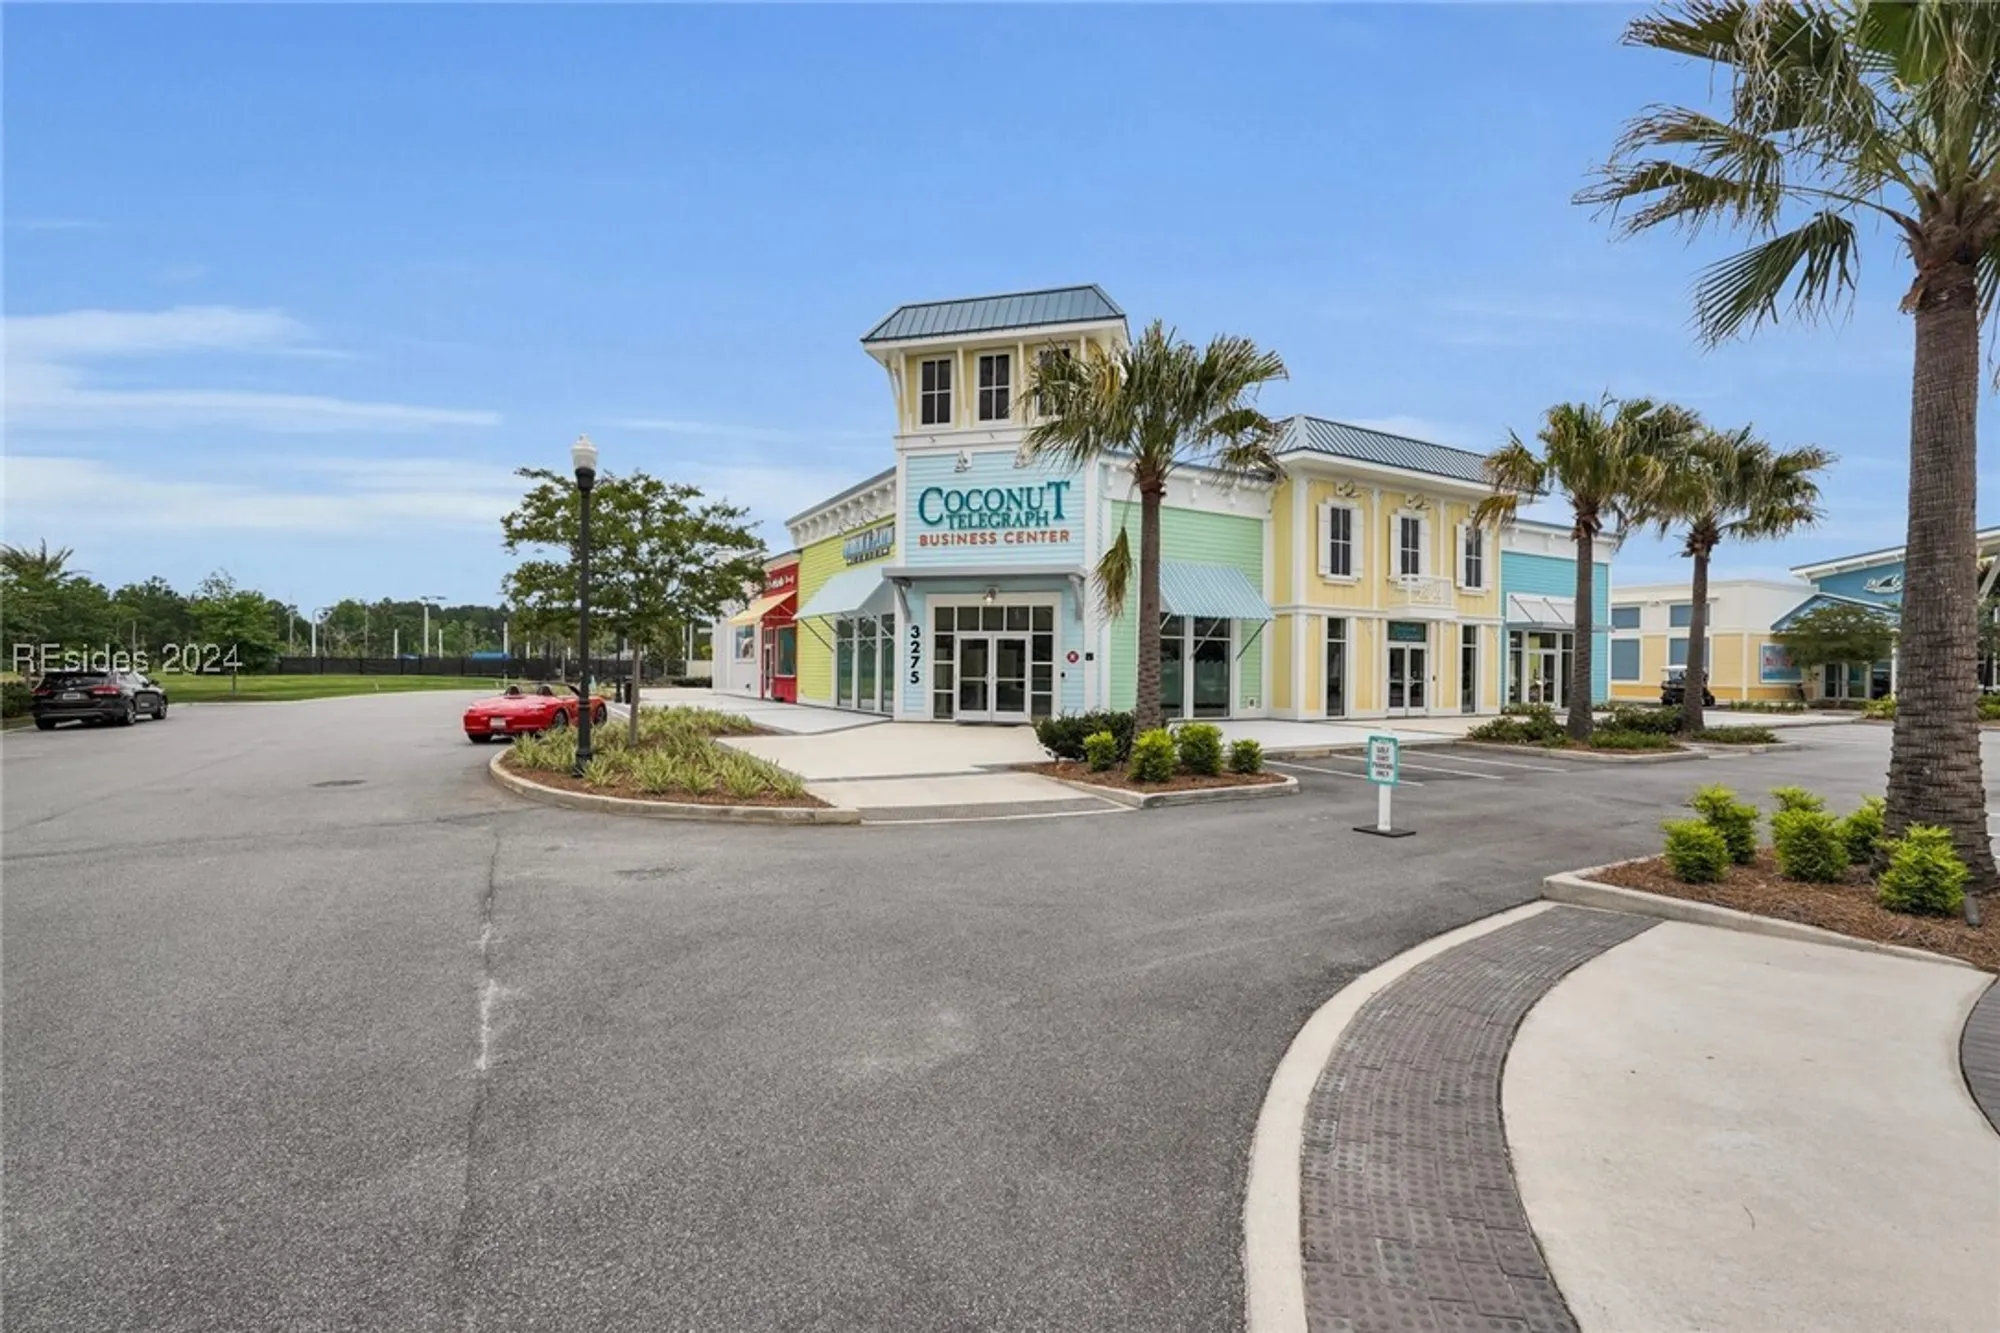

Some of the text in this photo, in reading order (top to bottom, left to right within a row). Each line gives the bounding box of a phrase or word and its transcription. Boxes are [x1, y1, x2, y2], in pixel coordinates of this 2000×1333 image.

[918, 480, 1070, 526] COCONUT
[946, 510, 1049, 530] TELEGRAPH
[919, 530, 1070, 547] BUSINESS CENTER
[910, 625, 921, 685] 3275
